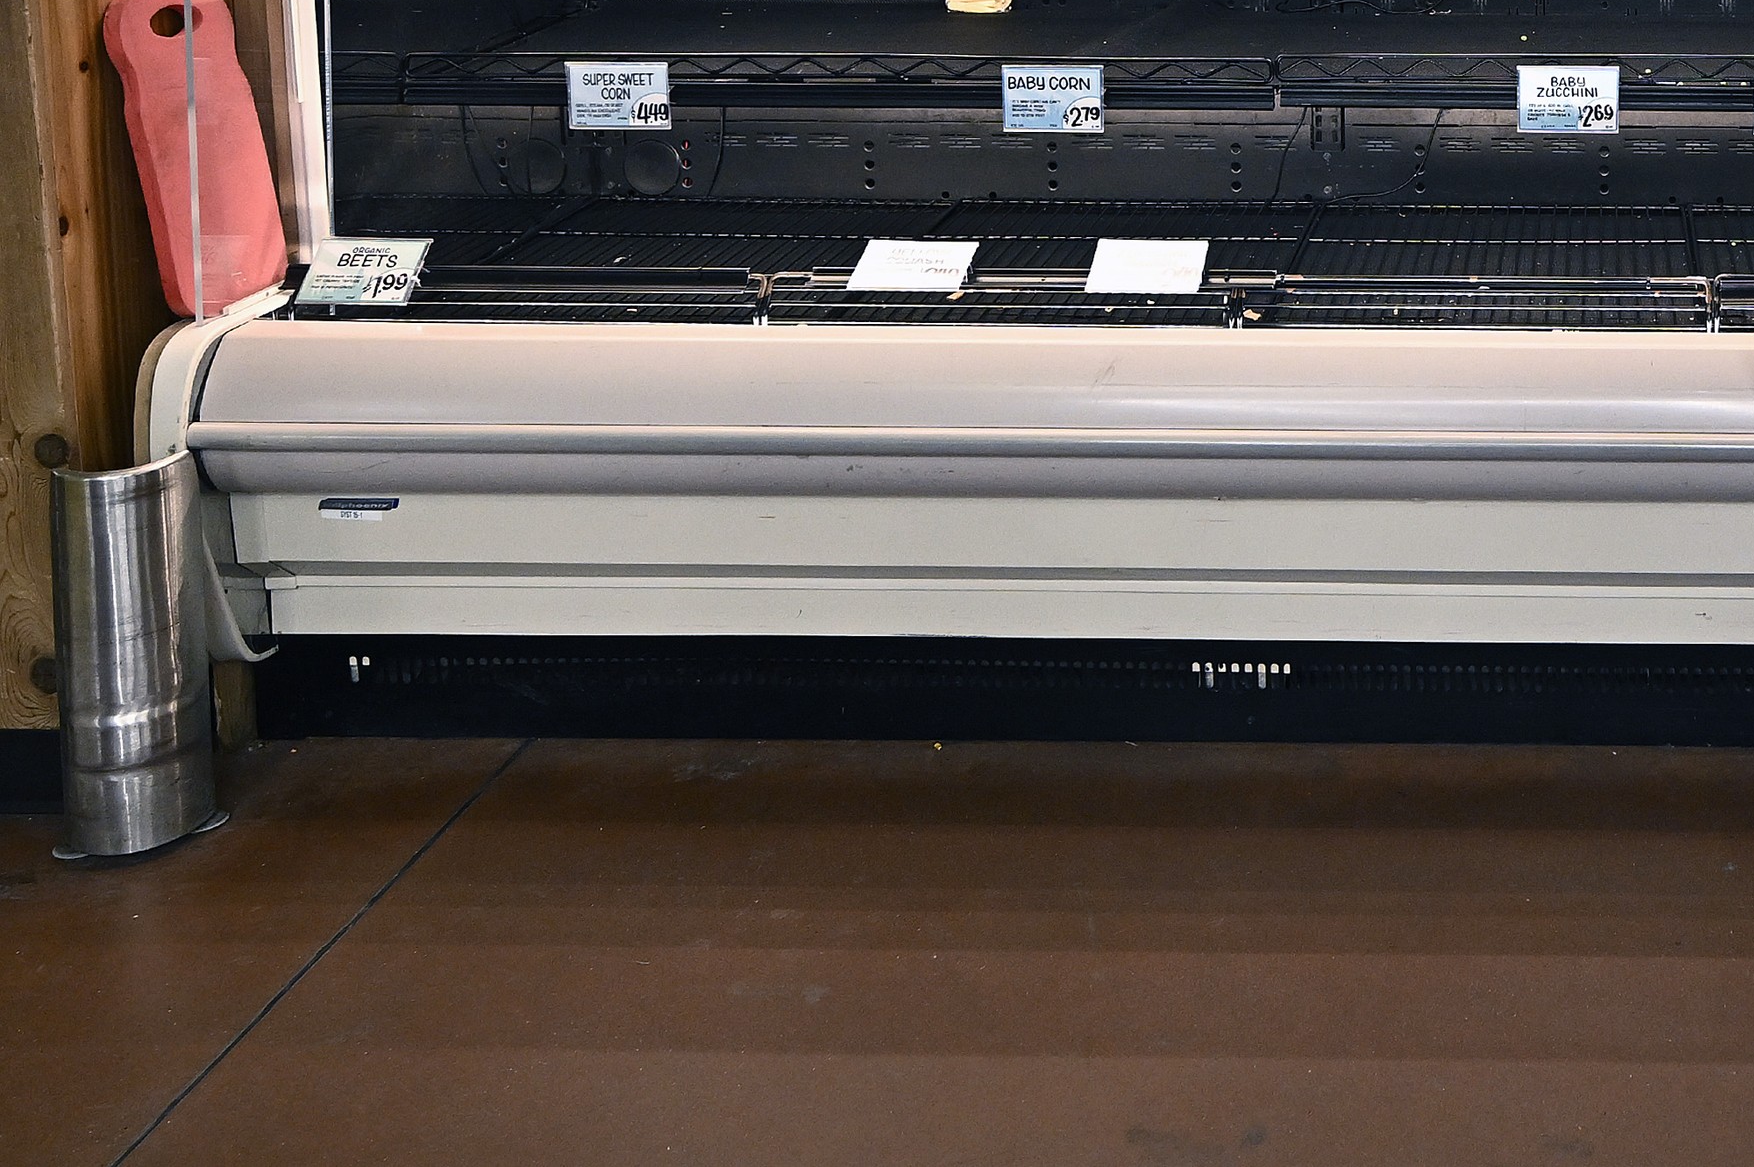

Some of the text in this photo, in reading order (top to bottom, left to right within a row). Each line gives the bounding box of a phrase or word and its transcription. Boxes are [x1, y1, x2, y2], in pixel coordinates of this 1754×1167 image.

[582, 73, 654, 86] SUPER SWEET
[1008, 76, 1090, 90] BABY CORN
[1551, 76, 1585, 87] BABY
[602, 87, 631, 99] CORN
[1536, 88, 1598, 97] ZUCCHINI
[337, 254, 398, 268] BEETS
